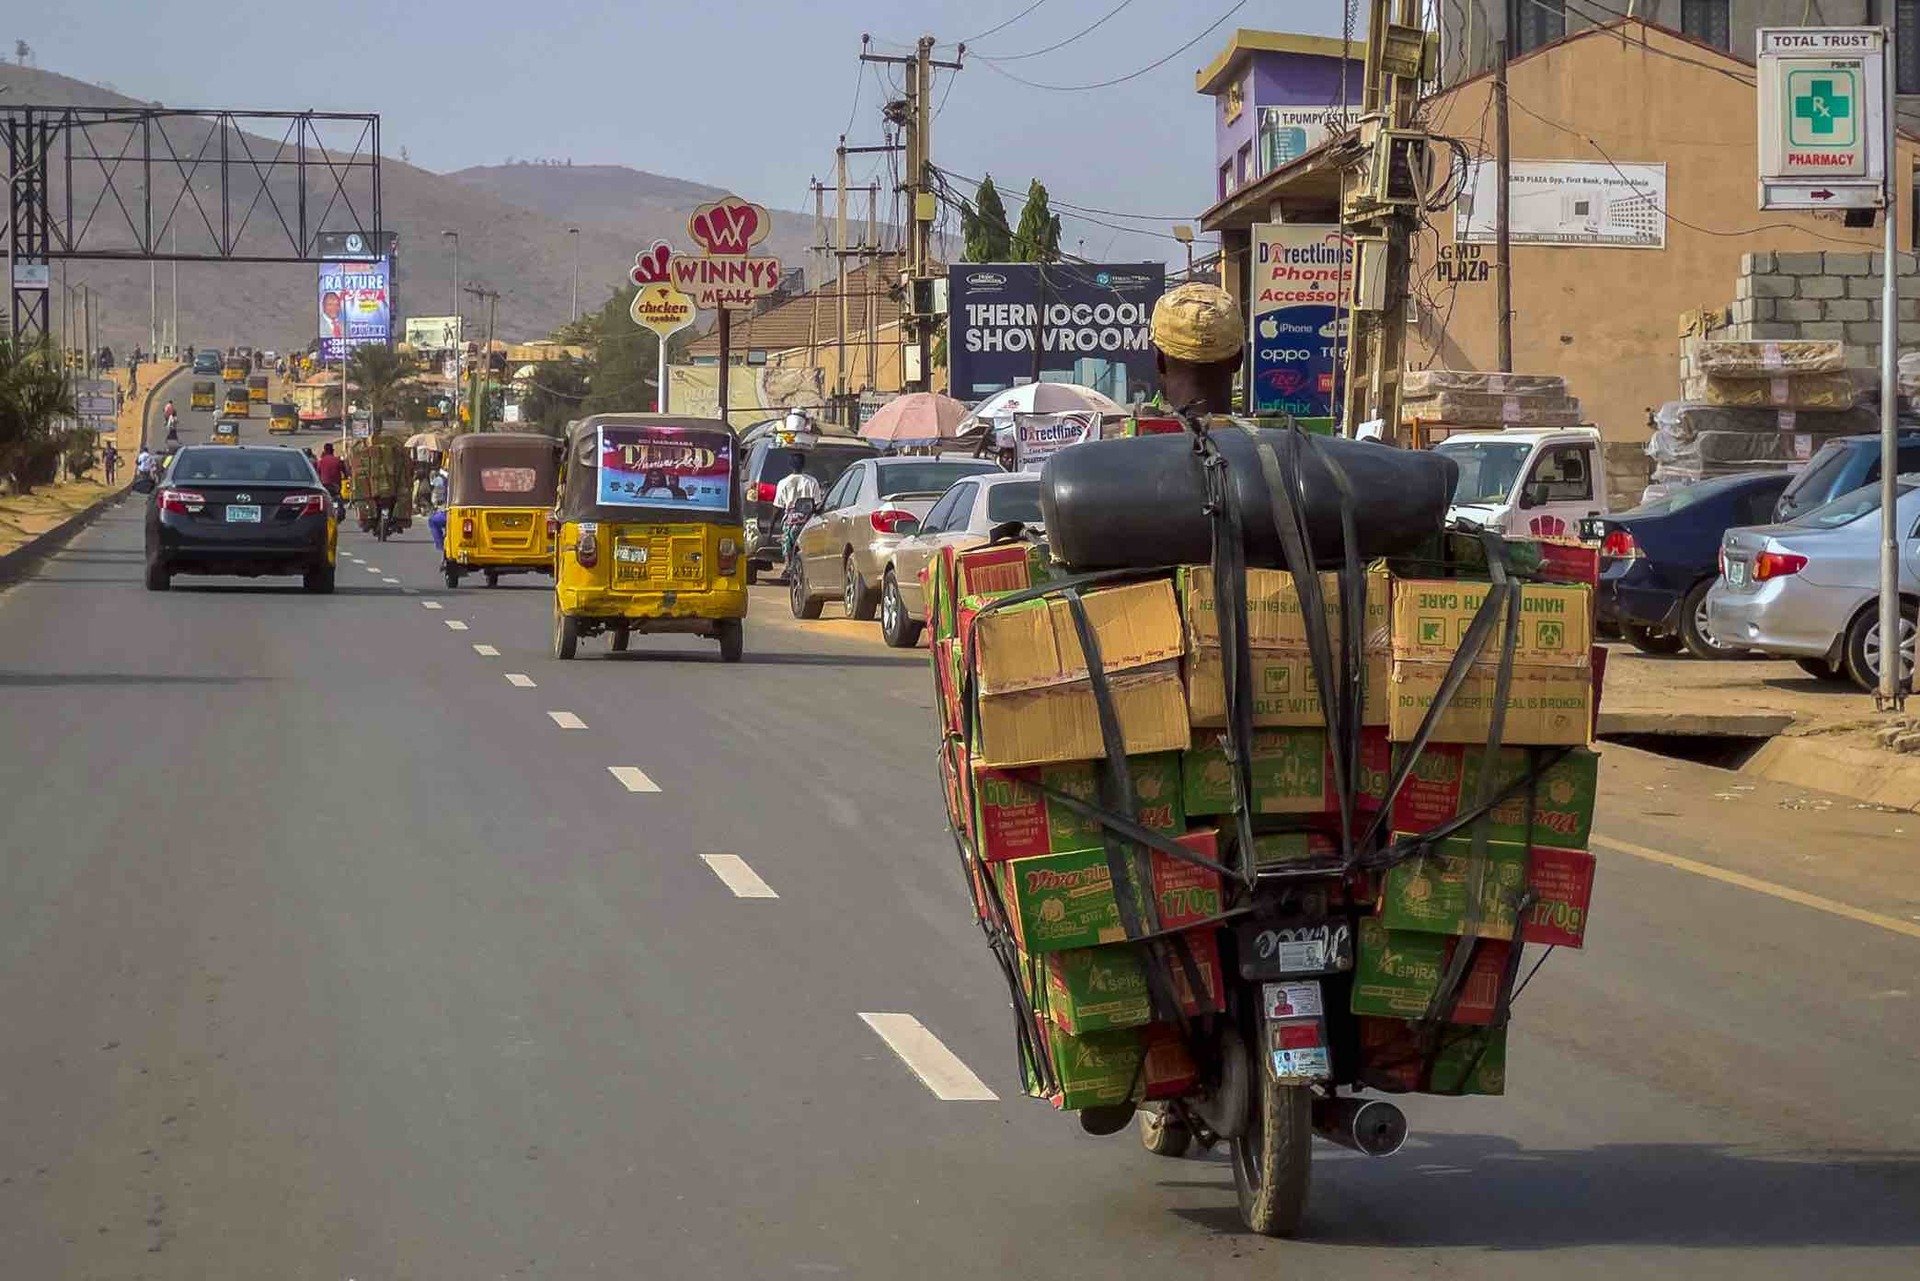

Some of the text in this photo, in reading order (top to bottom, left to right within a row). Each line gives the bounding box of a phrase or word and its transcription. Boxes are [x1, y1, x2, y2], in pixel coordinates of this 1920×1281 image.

[1774, 36, 1868, 47] TOTAL TRUST
[1788, 154, 1854, 165] PHARMACY
[1441, 245, 1480, 259] GMD
[676, 261, 778, 289] WINNYS
[1272, 267, 1352, 281] Phones
[1437, 261, 1488, 281] PLAZA
[1309, 281, 1319, 290] &
[702, 289, 752, 306] MEALS
[638, 301, 688, 314] chicken
[965, 303, 1150, 326] THERMOCOOL
[1280, 323, 1313, 333] iPhone
[965, 327, 1149, 352] SHOWROOM
[1260, 349, 1311, 363] oppo
[1418, 593, 1458, 610] CARE
